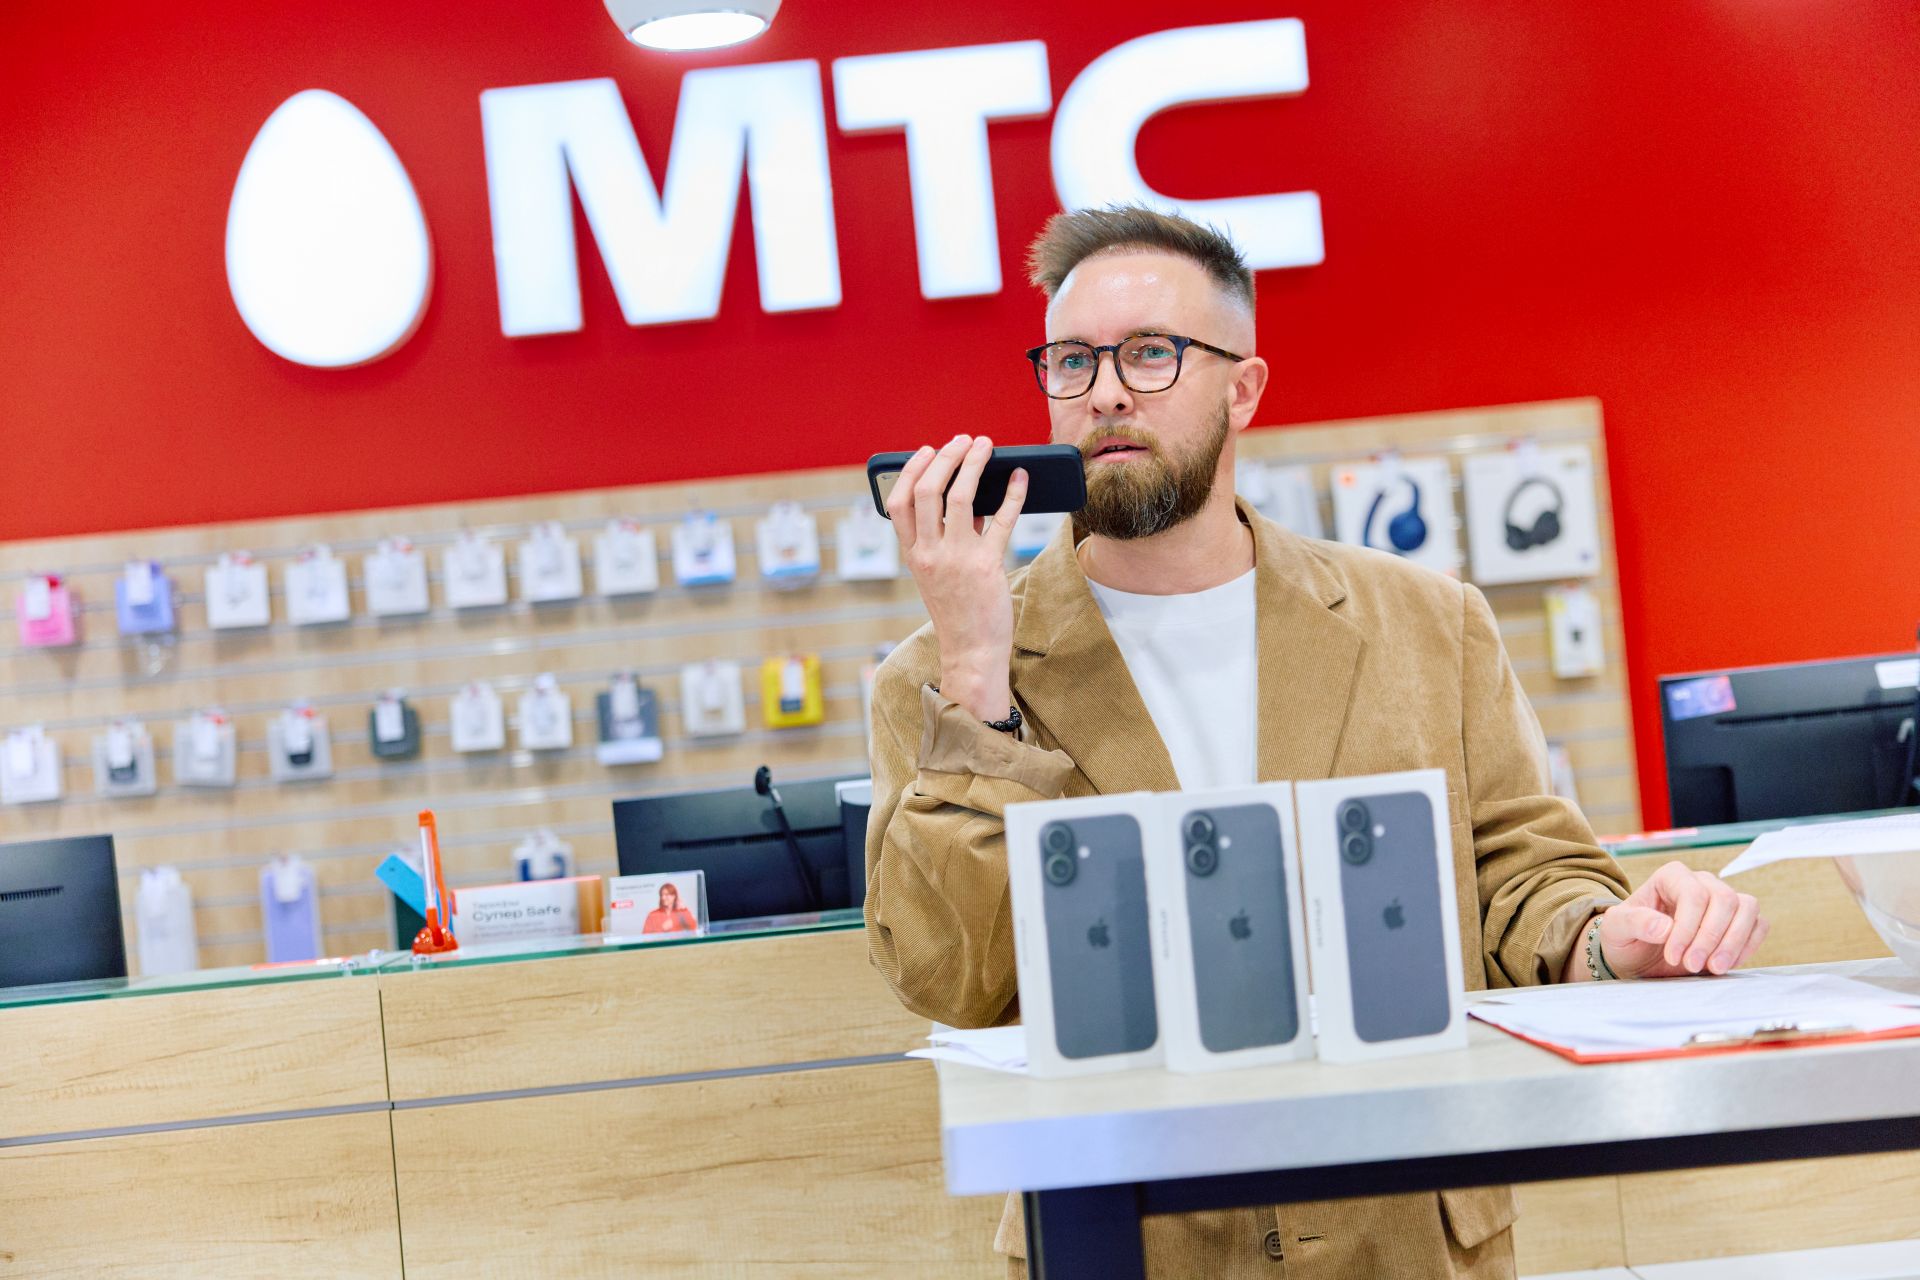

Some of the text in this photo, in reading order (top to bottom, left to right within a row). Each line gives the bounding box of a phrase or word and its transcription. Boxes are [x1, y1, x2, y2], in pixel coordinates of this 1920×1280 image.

[481, 17, 1324, 338] МТС
[472, 905, 562, 923] Супер Safe
